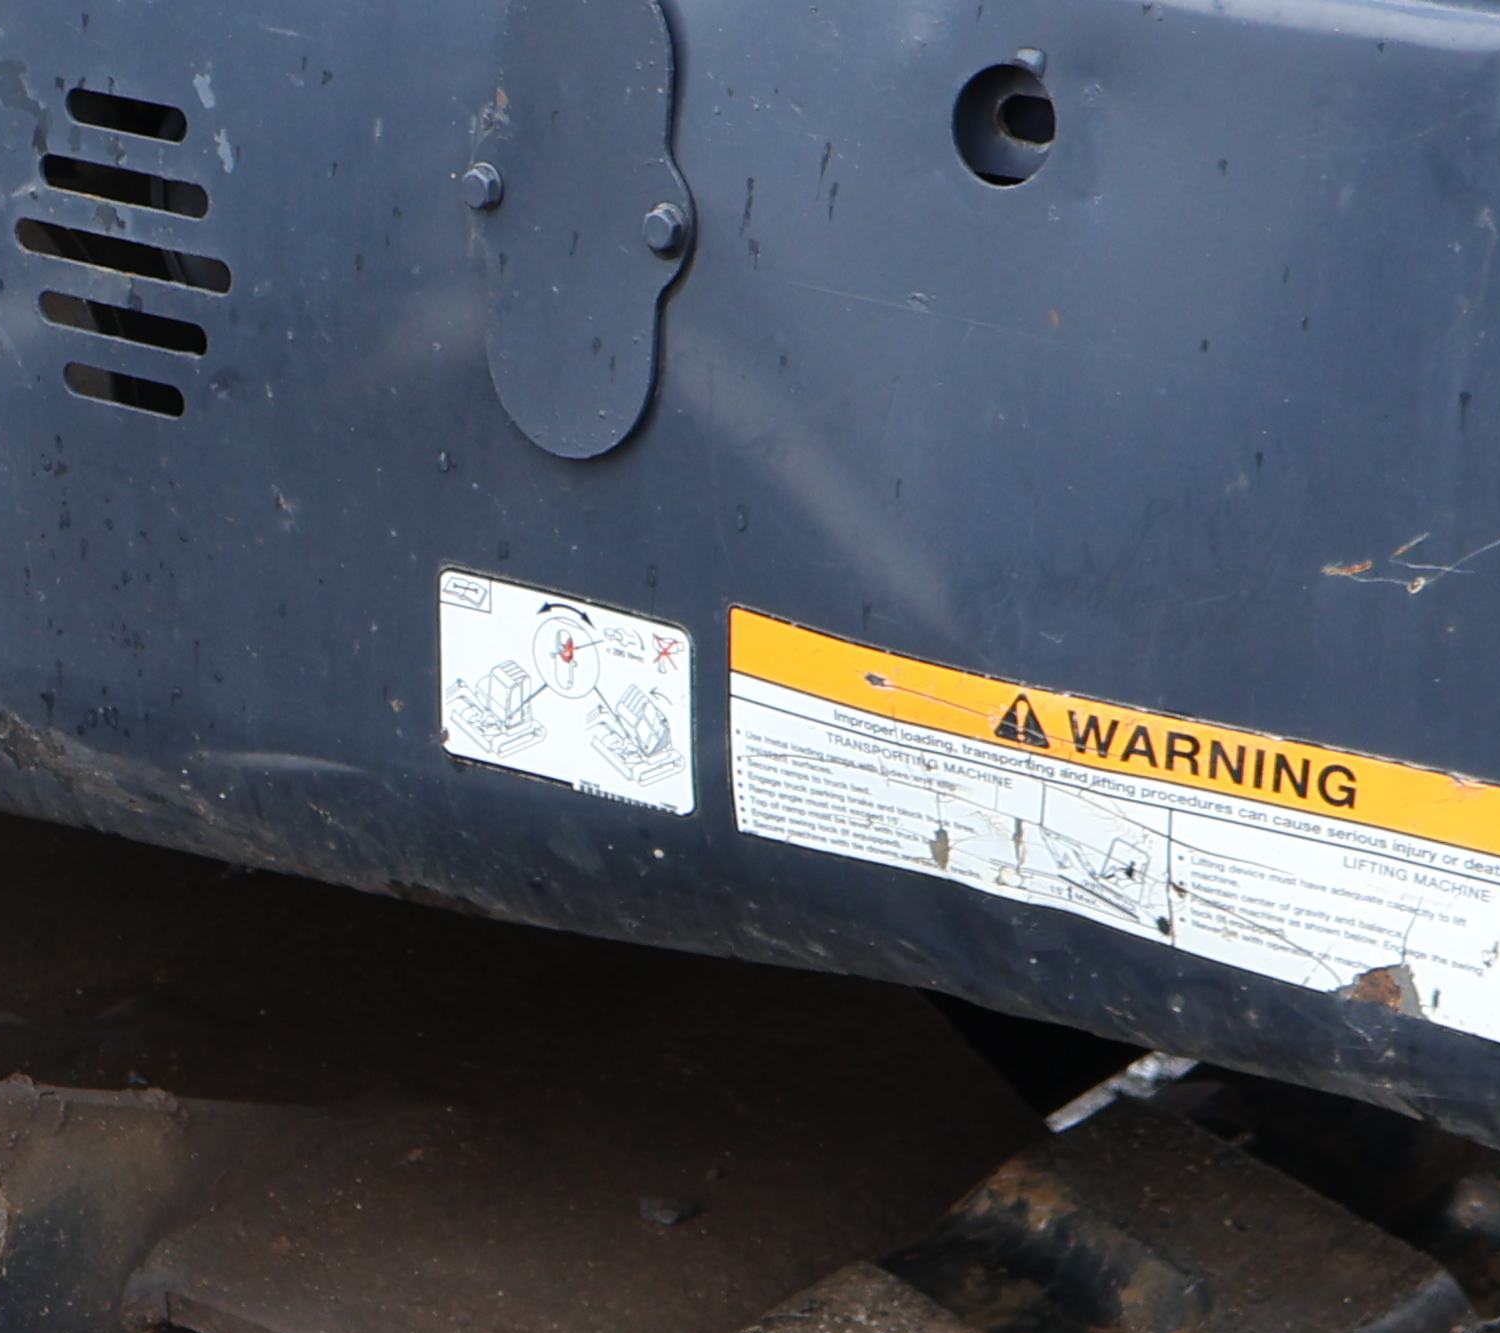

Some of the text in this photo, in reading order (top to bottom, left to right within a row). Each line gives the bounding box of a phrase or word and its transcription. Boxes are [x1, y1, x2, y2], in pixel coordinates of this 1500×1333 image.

[745, 730, 762, 743] Use
[826, 731, 1015, 789] TRANSPORTING MACHINE
[1067, 709, 1357, 811] WARNING
[833, 709, 897, 735] Improper
[900, 728, 958, 753] loading,
[962, 744, 1055, 778] transporting
[1059, 767, 1088, 783] and
[1092, 774, 1136, 797] lifting
[1141, 787, 1233, 815] procedures
[1238, 808, 1268, 823] can
[1272, 815, 1322, 835] cause
[1327, 827, 1387, 849] serious
[1392, 839, 1438, 863] injury
[1441, 854, 1460, 866] or
[1190, 855, 1226, 873] Lifting
[1228, 865, 1266, 880] device
[1268, 873, 1297, 887] must
[1299, 879, 1328, 892] have
[1342, 855, 1493, 903] LIFTING MACHINE
